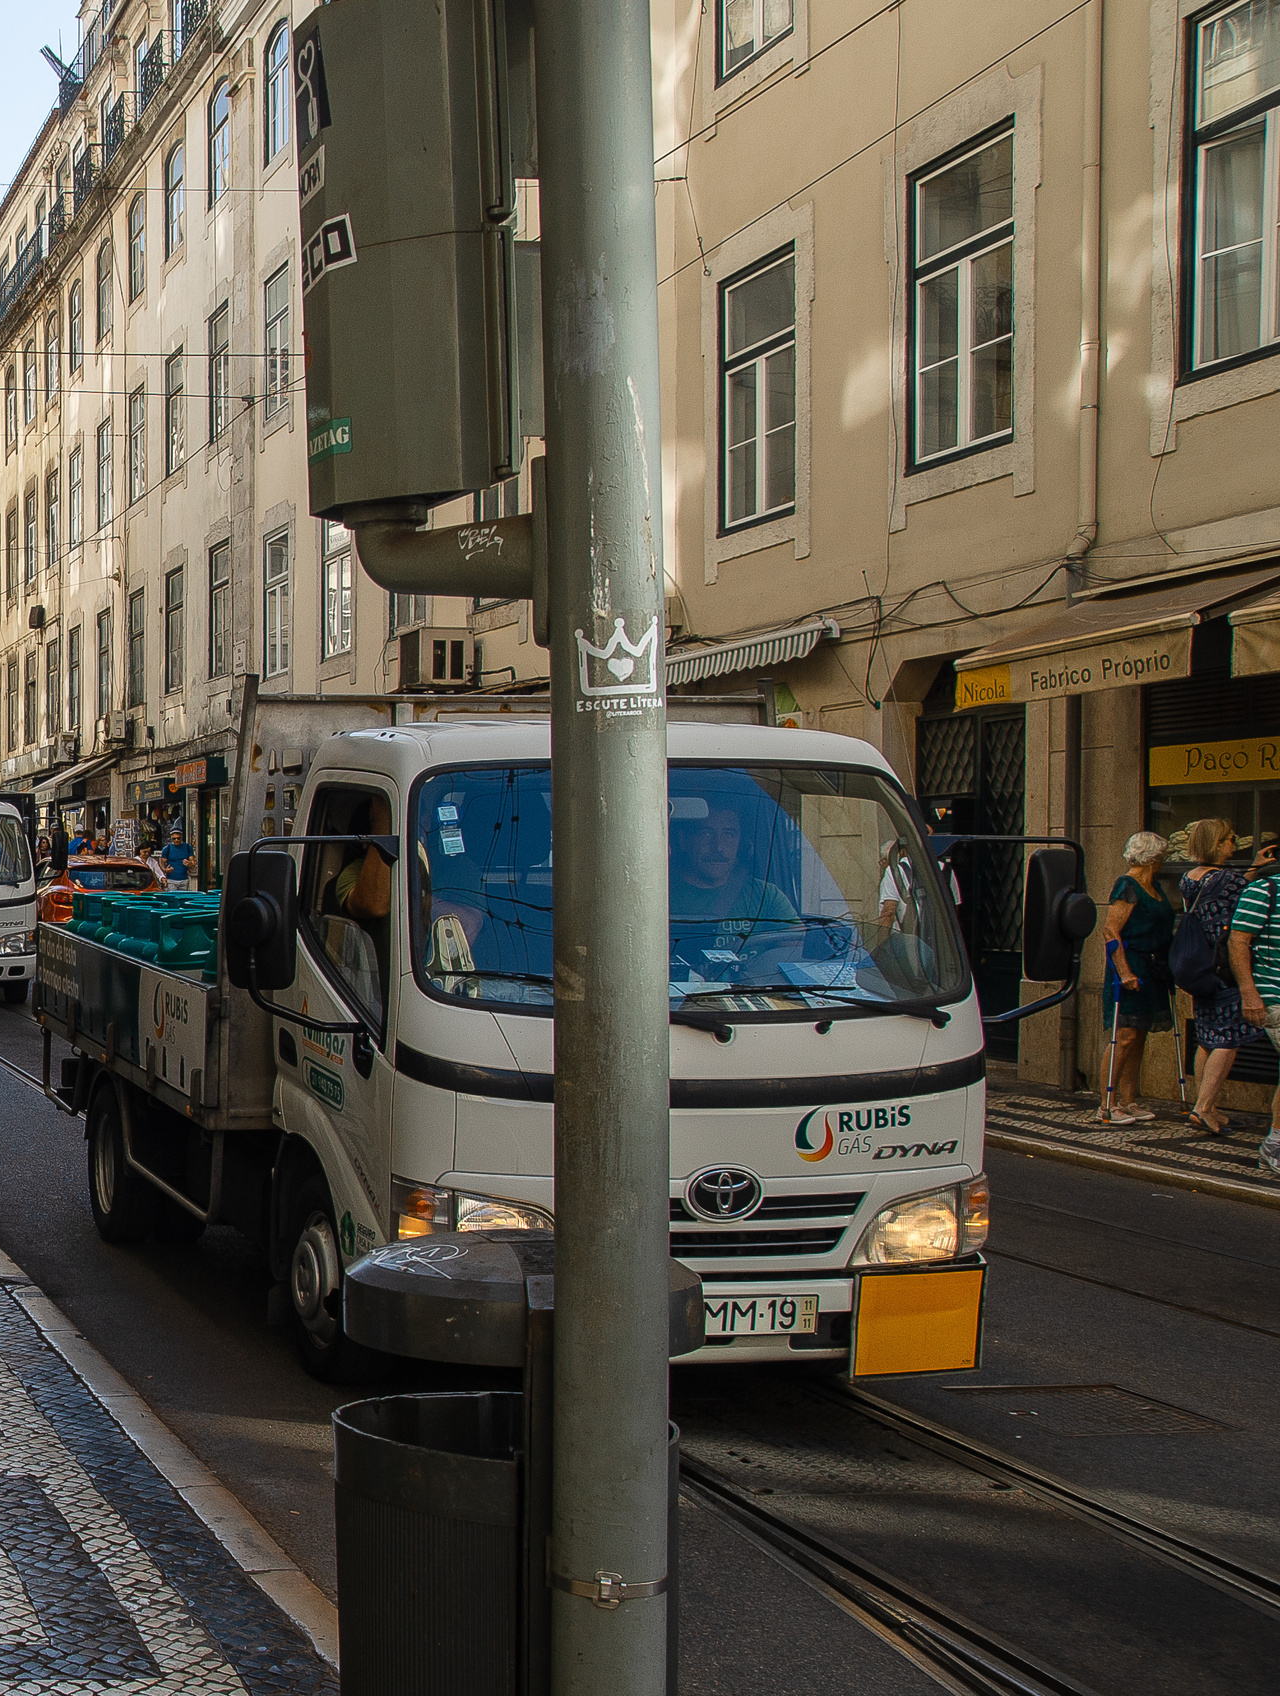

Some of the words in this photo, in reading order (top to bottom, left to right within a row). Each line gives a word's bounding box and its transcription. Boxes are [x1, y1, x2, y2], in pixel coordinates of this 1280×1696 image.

[963, 679, 1006, 703] Nicola
[1030, 665, 1091, 692] Fabrico
[1101, 650, 1170, 680] Próprio
[576, 698, 628, 713] ESCUTE
[1257, 743, 1280, 772] R
[837, 1133, 872, 1156] GÁS
[872, 1140, 959, 1160] DYNA
[804, 1299, 813, 1311] 11
[802, 1318, 811, 1329] 11
